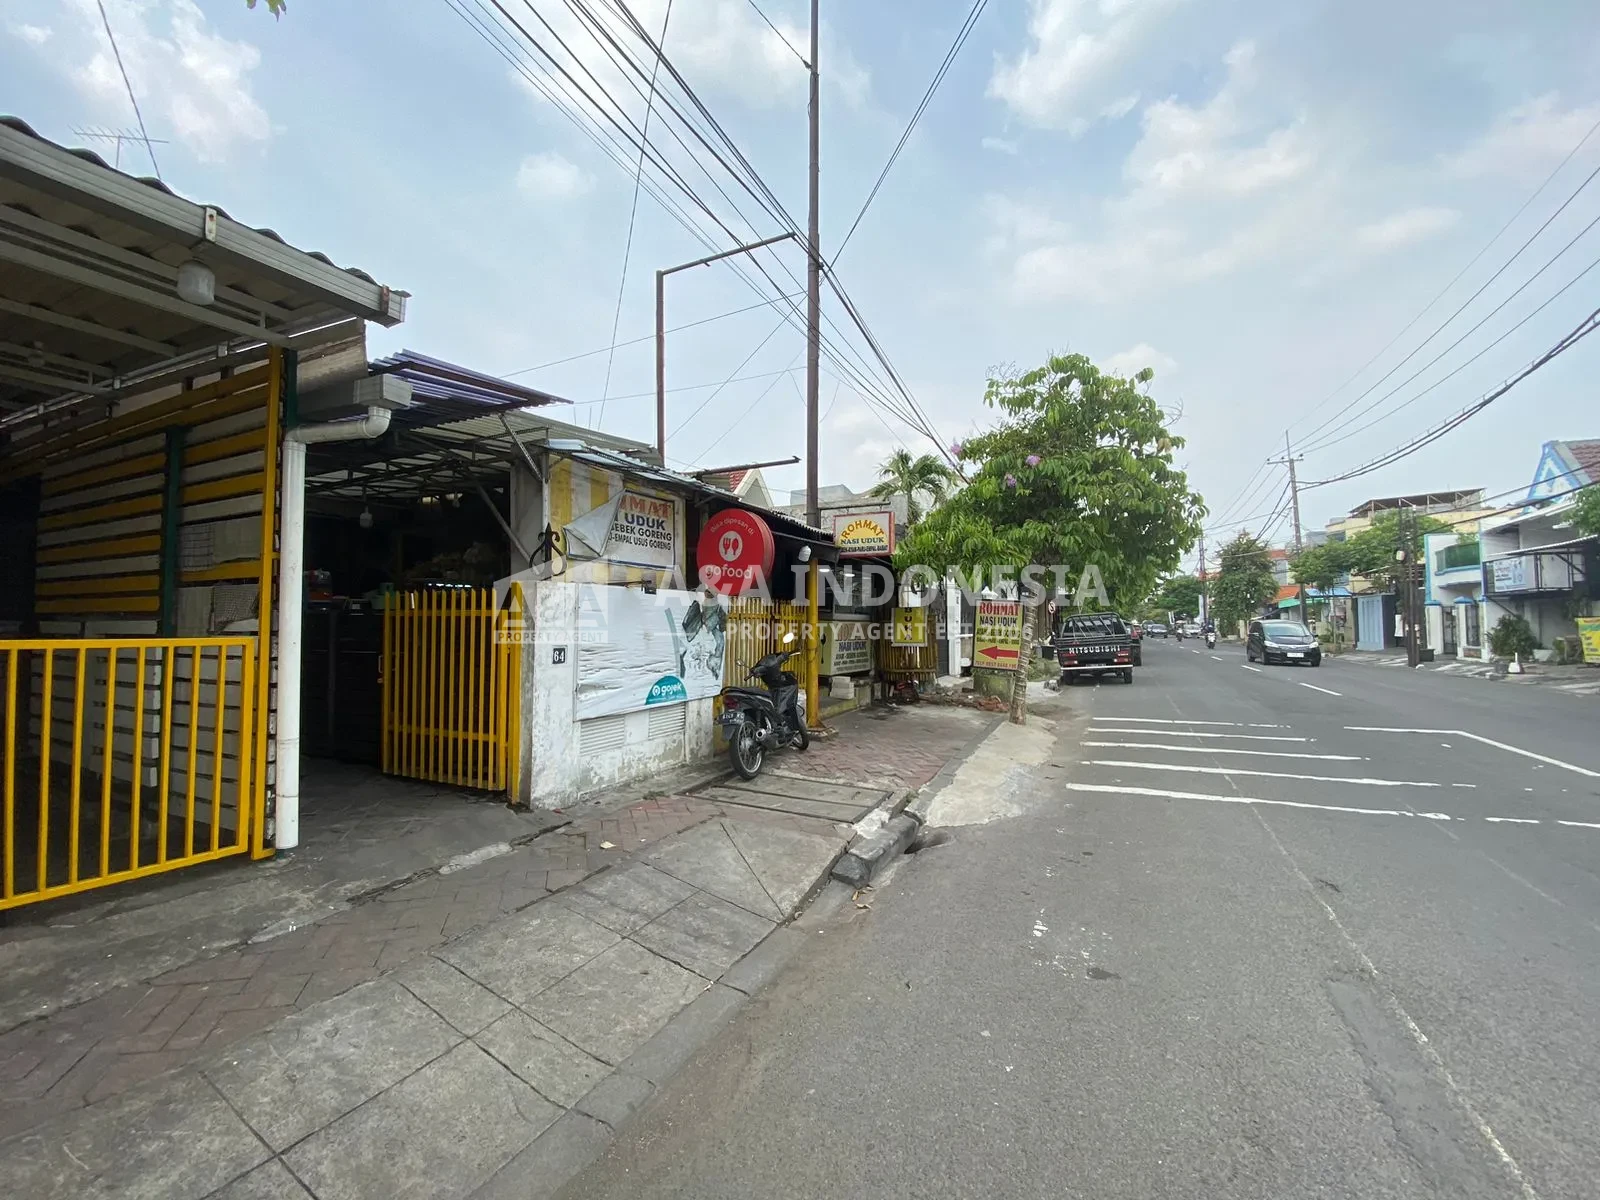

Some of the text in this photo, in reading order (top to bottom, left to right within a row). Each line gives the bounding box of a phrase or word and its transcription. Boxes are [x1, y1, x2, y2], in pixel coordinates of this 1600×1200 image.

[625, 512, 665, 530] UDUK
[638, 528, 672, 541] GORENG
[841, 520, 884, 538] ROHMAT
[634, 536, 648, 547] USUS
[649, 540, 671, 550] GORENG
[705, 563, 752, 579] gofood
[979, 602, 1019, 616] ROHMAT
[980, 616, 1017, 627] NASI UDUK
[553, 650, 565, 663] 64
[1069, 645, 1120, 654] MITSUBISHI
[661, 682, 682, 696] gojek
